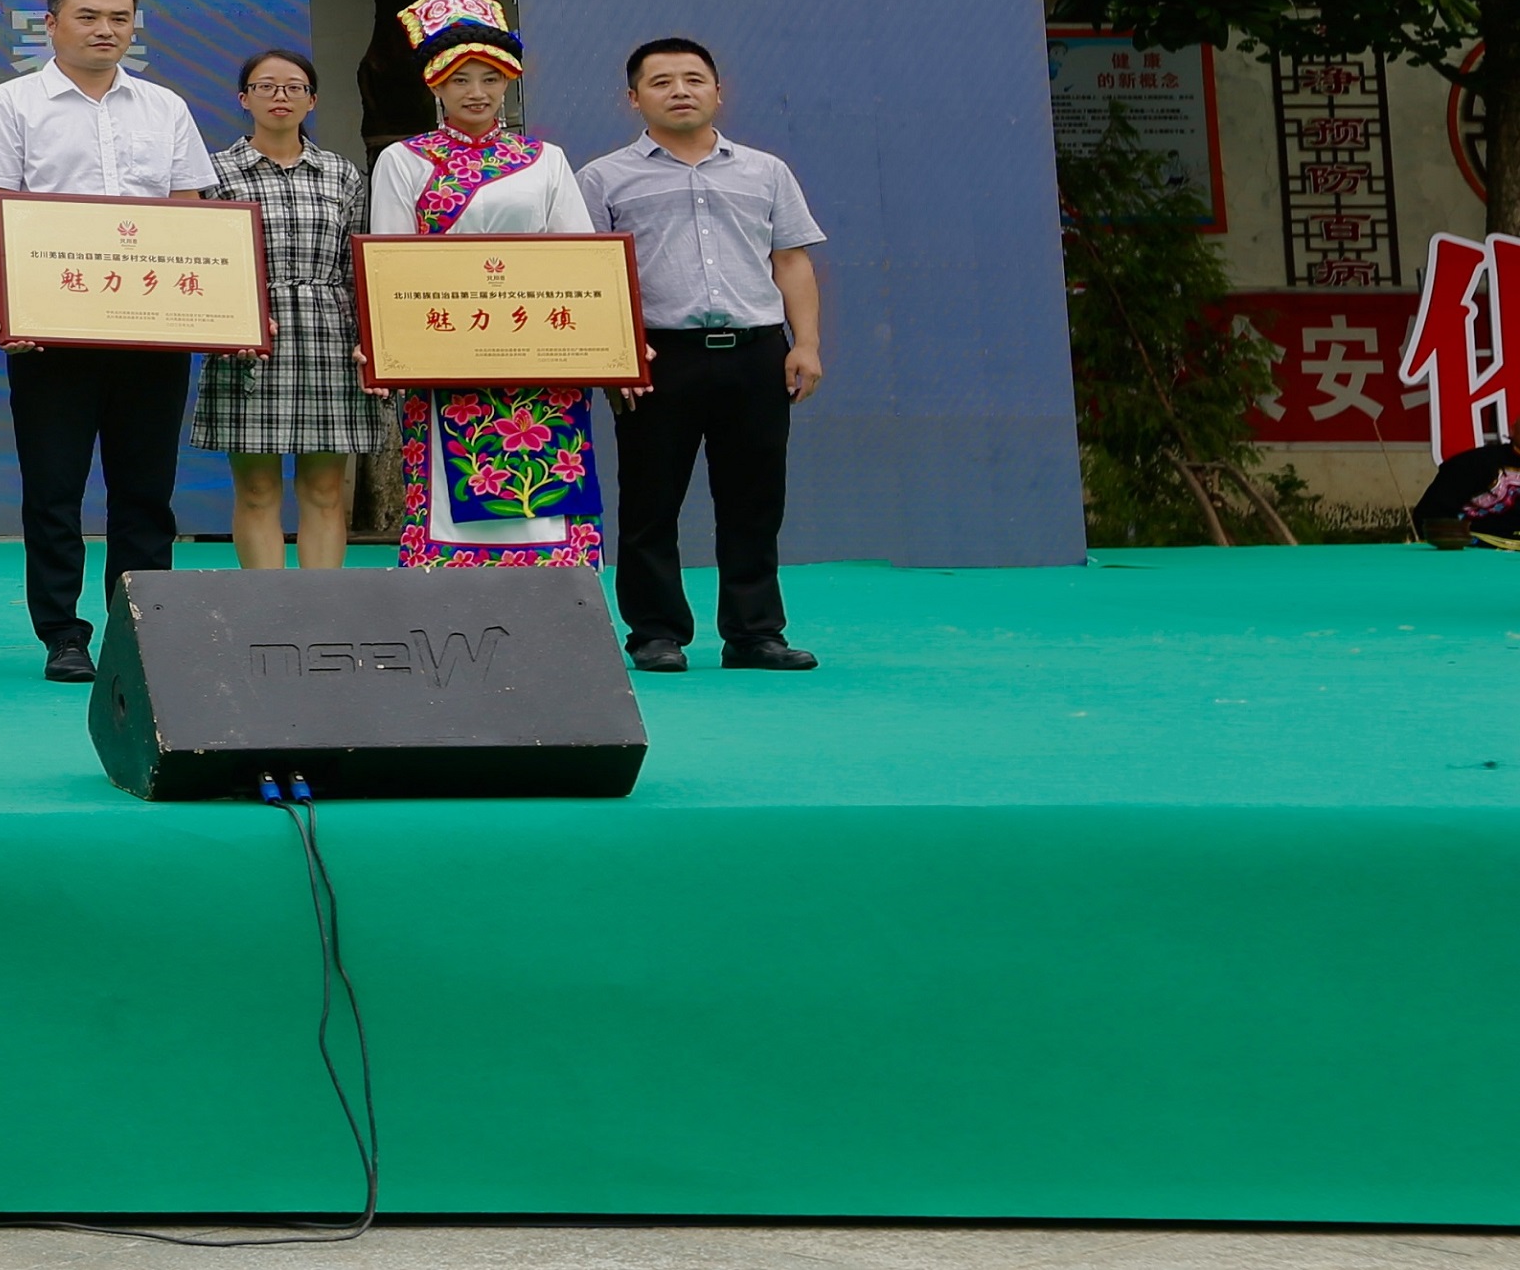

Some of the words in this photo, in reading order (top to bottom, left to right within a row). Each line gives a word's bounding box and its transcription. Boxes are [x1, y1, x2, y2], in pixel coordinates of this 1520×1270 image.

[1097, 73, 1179, 90] 的新概念
[1300, 24, 1376, 287] 净预防百病
[59, 267, 205, 298] 魅力乡镇
[424, 305, 578, 333] 魅力乡镇
